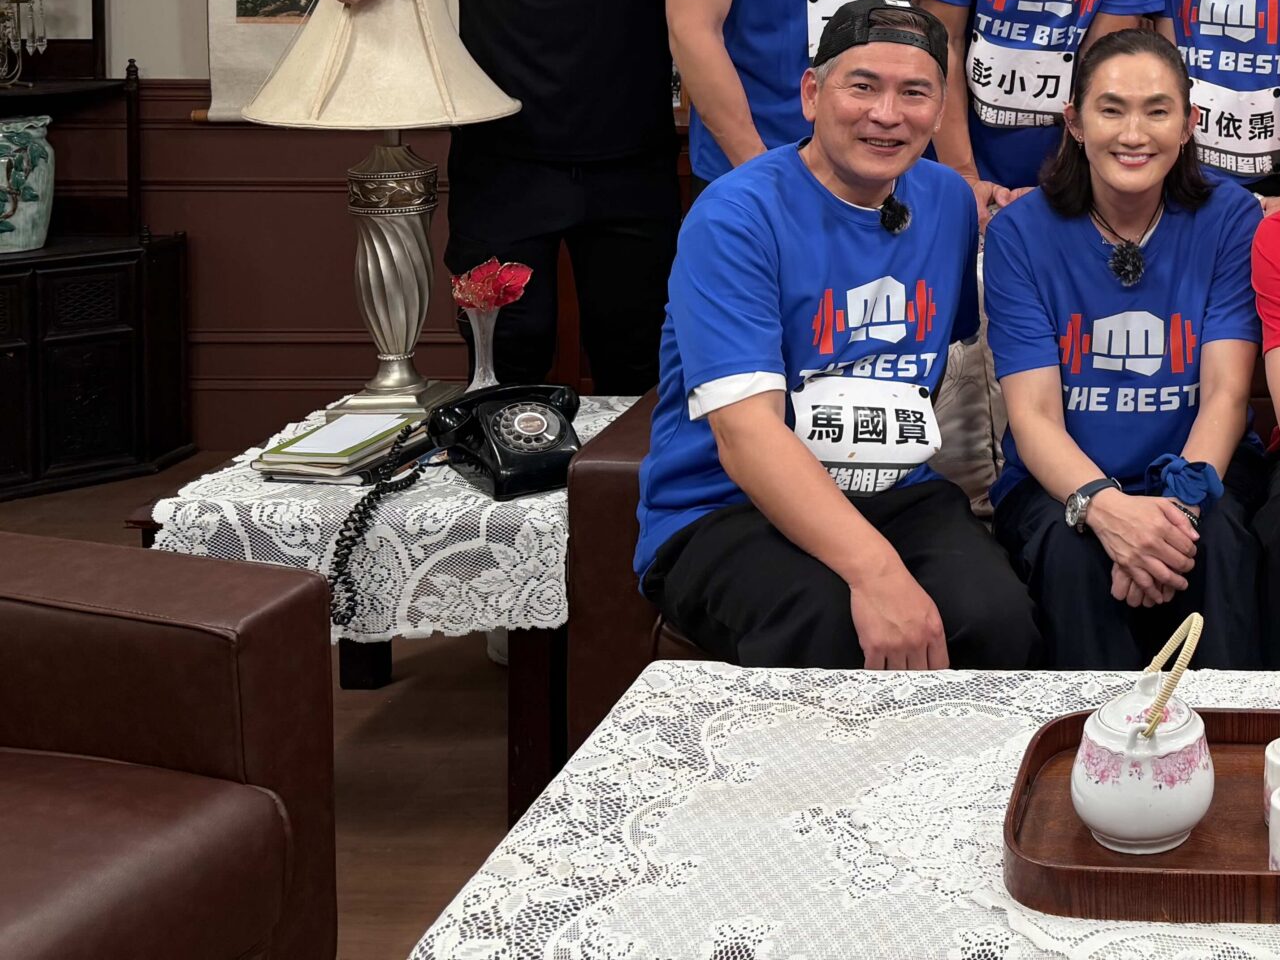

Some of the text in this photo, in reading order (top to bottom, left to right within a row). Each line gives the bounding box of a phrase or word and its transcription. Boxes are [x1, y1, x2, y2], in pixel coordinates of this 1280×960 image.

[977, 13, 1029, 42] THE
[1178, 45, 1214, 70] THE
[971, 56, 1061, 99] 彭小刀
[852, 352, 938, 378] BEST
[1116, 382, 1200, 412] BEST
[807, 404, 930, 446] 馬國賢
[824, 467, 913, 492] 強明星
